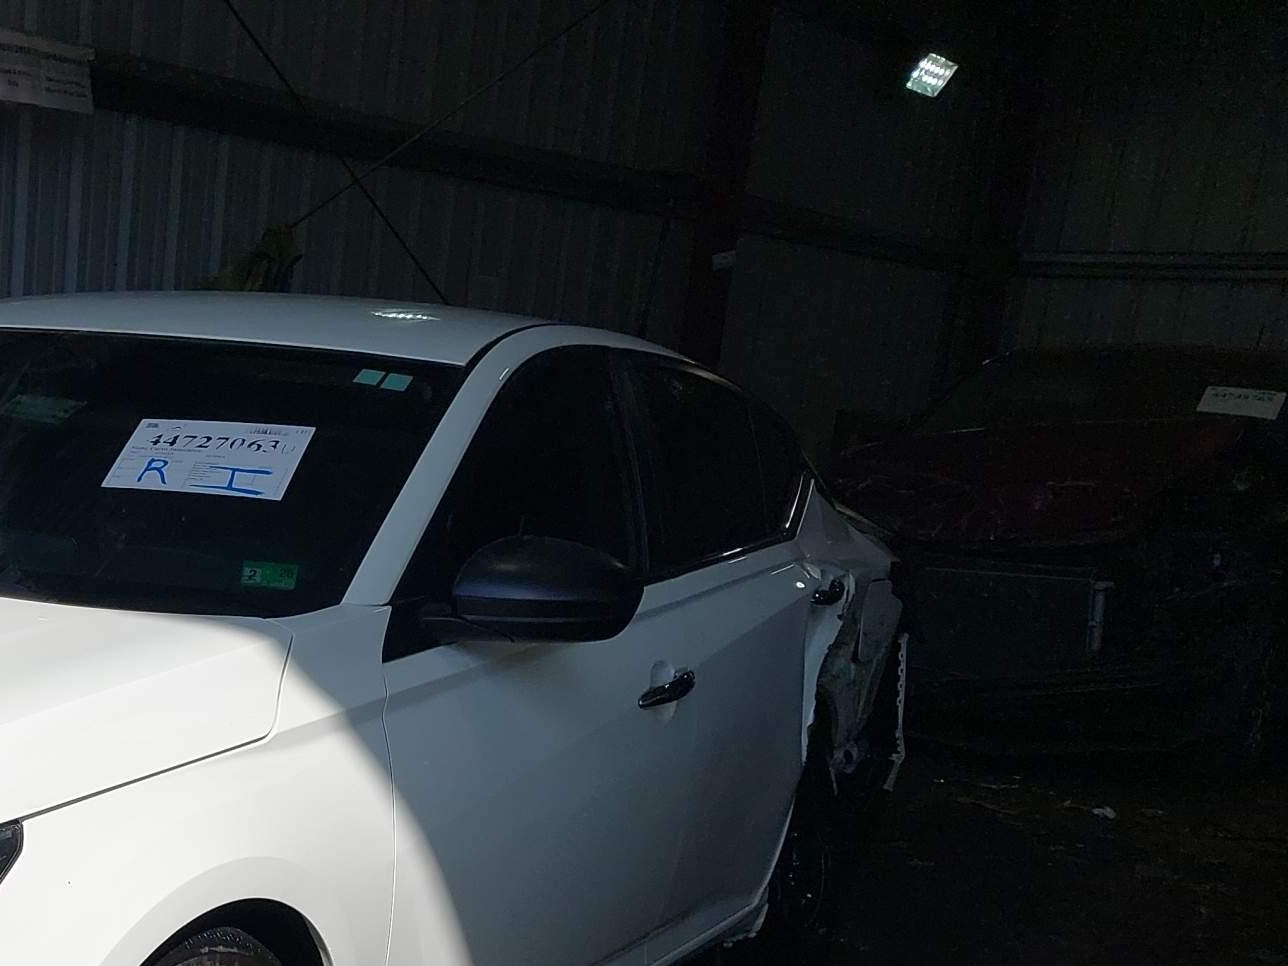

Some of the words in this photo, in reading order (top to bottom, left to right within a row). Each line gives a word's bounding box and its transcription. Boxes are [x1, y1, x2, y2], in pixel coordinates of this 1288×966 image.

[146, 433, 281, 454] 44727063
[136, 457, 169, 485] R
[188, 464, 273, 496] I
[248, 569, 257, 581] 2
